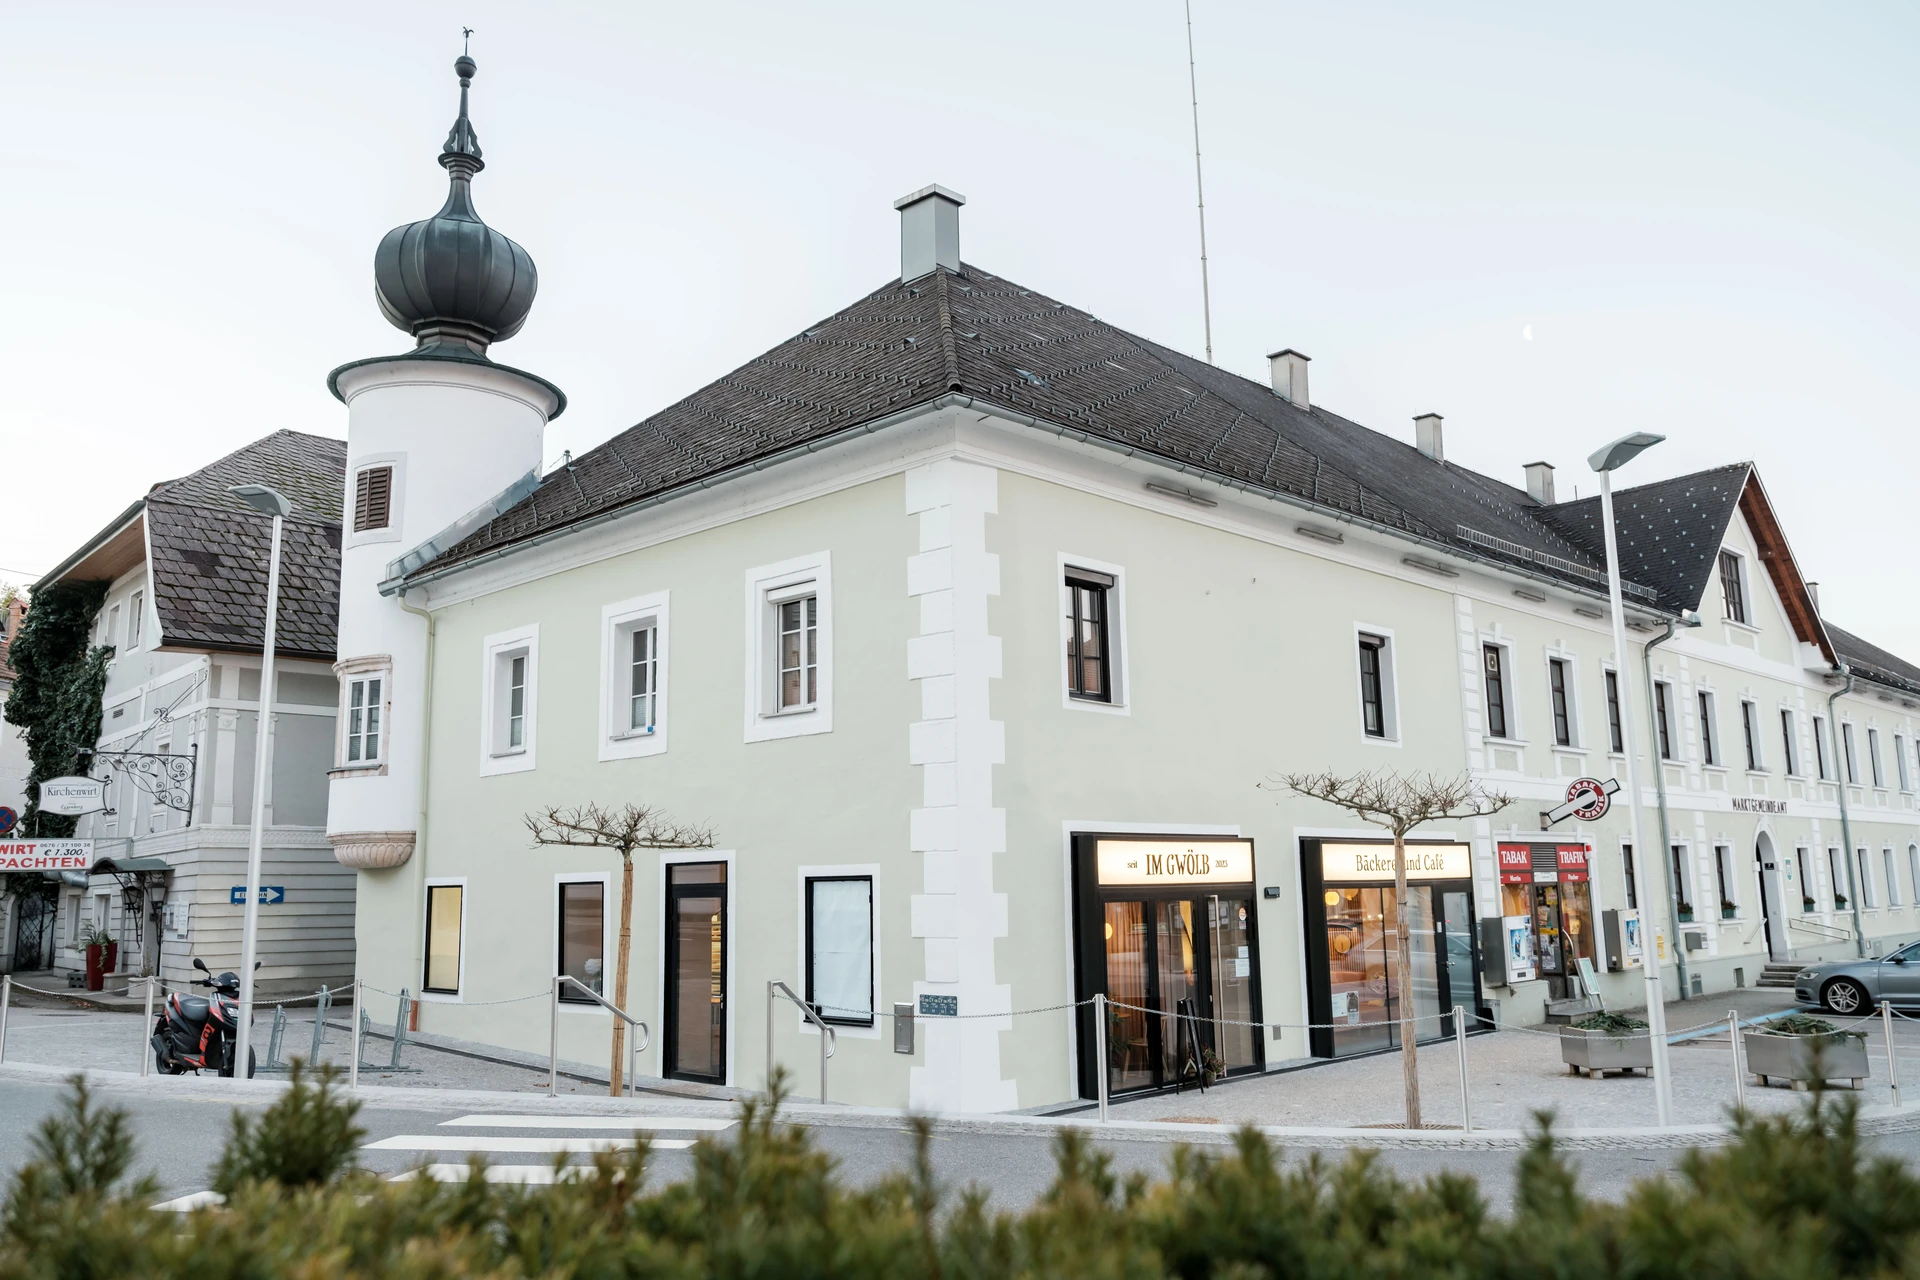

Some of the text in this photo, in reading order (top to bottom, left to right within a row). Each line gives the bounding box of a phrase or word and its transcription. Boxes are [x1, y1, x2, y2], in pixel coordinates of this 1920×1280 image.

[47, 786, 98, 796] Kirchenwirt
[1569, 781, 1596, 800] TABAK
[1578, 795, 1604, 818] TRAFIK
[1731, 797, 1788, 814] MARKTGEMEINDEAMT
[44, 848, 88, 857] € 1.300,-
[1501, 850, 1528, 864] TABAK
[1559, 851, 1585, 864] TRAFIK
[1127, 848, 1228, 876] seit IM GWÖLB 2023
[1356, 854, 1397, 872] Bäckere
[1423, 853, 1445, 871] Café
